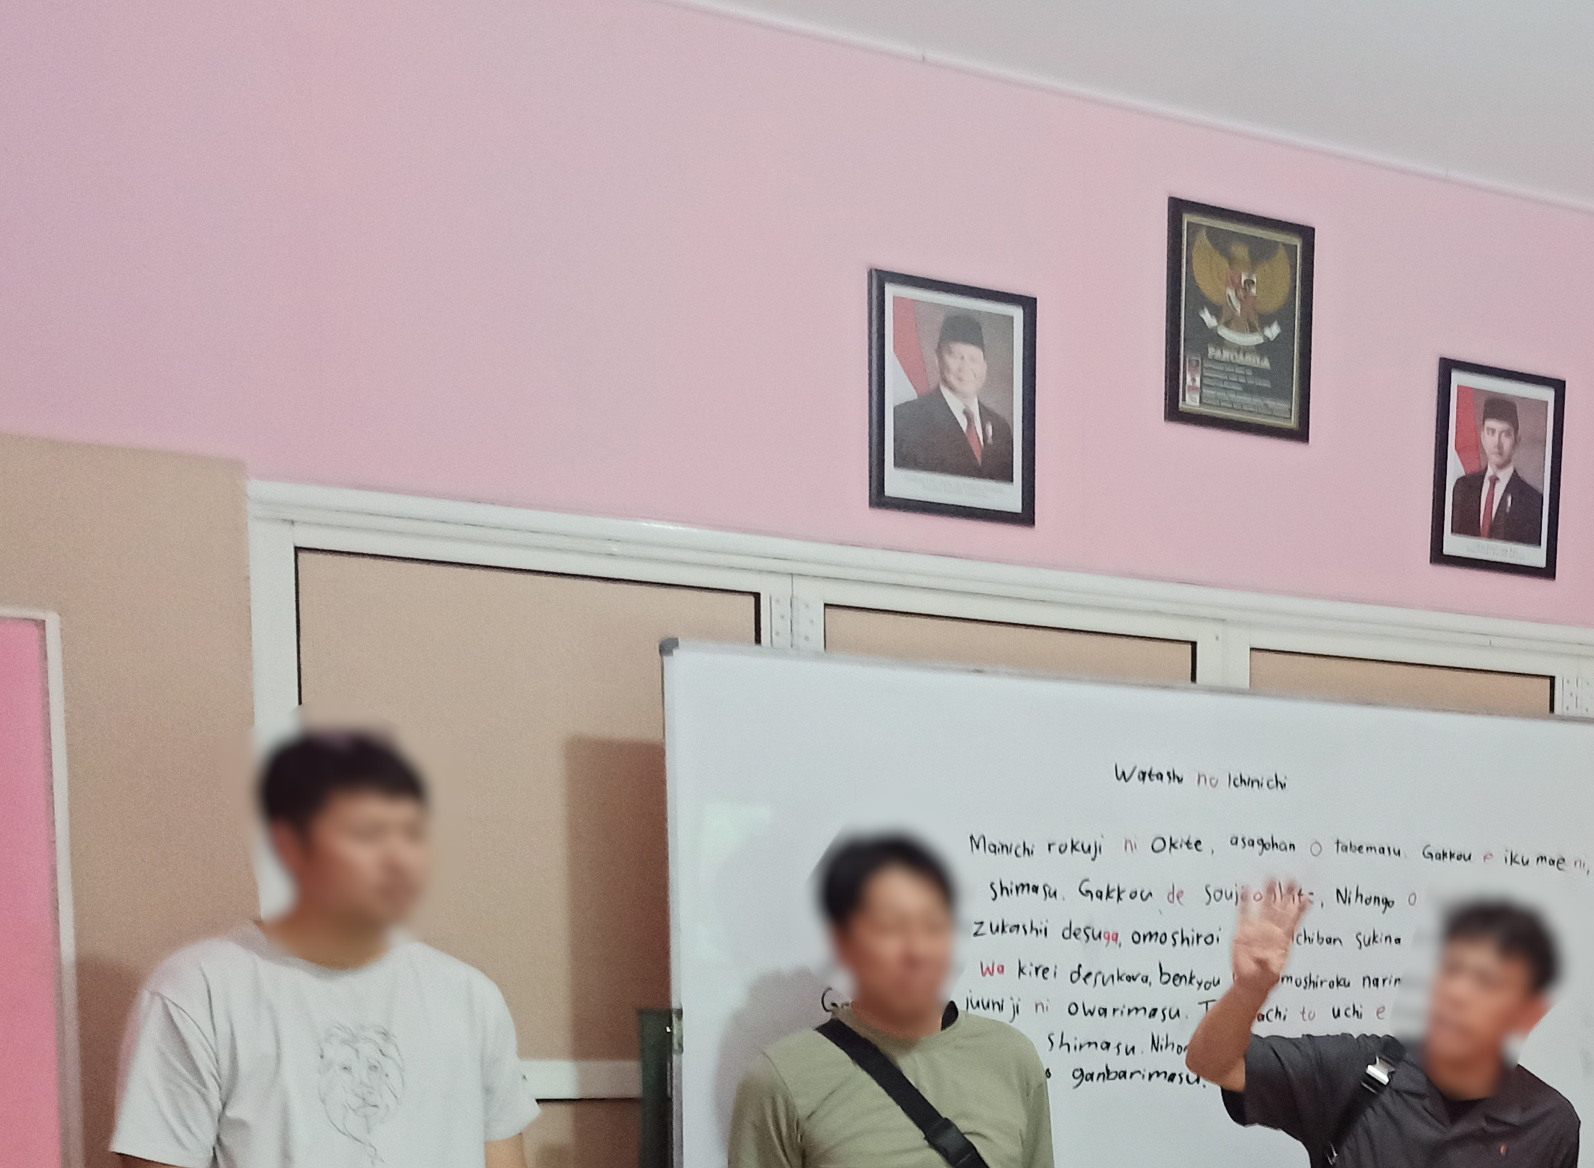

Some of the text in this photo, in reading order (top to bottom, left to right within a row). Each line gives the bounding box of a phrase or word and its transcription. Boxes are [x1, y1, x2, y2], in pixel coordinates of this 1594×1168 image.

[1114, 762, 1287, 791] Watashi no Ichinichi
[969, 834, 1035, 858] Mainichi
[1047, 834, 1104, 862] rokuji
[1124, 836, 1137, 851] ni
[1230, 834, 1296, 856] asagohan
[1422, 845, 1472, 862] Gakkou
[1078, 878, 1153, 903] Gakkou
[1167, 882, 1185, 906] de
[1337, 884, 1395, 914] Nihongo
[1131, 927, 1221, 947] omoshiroi
[1017, 959, 1057, 980] kirei
[1158, 960, 1221, 992] benkyou
[1035, 998, 1050, 1014] ni
[1300, 1006, 1316, 1021] to
[1332, 1002, 1363, 1020] uchi
